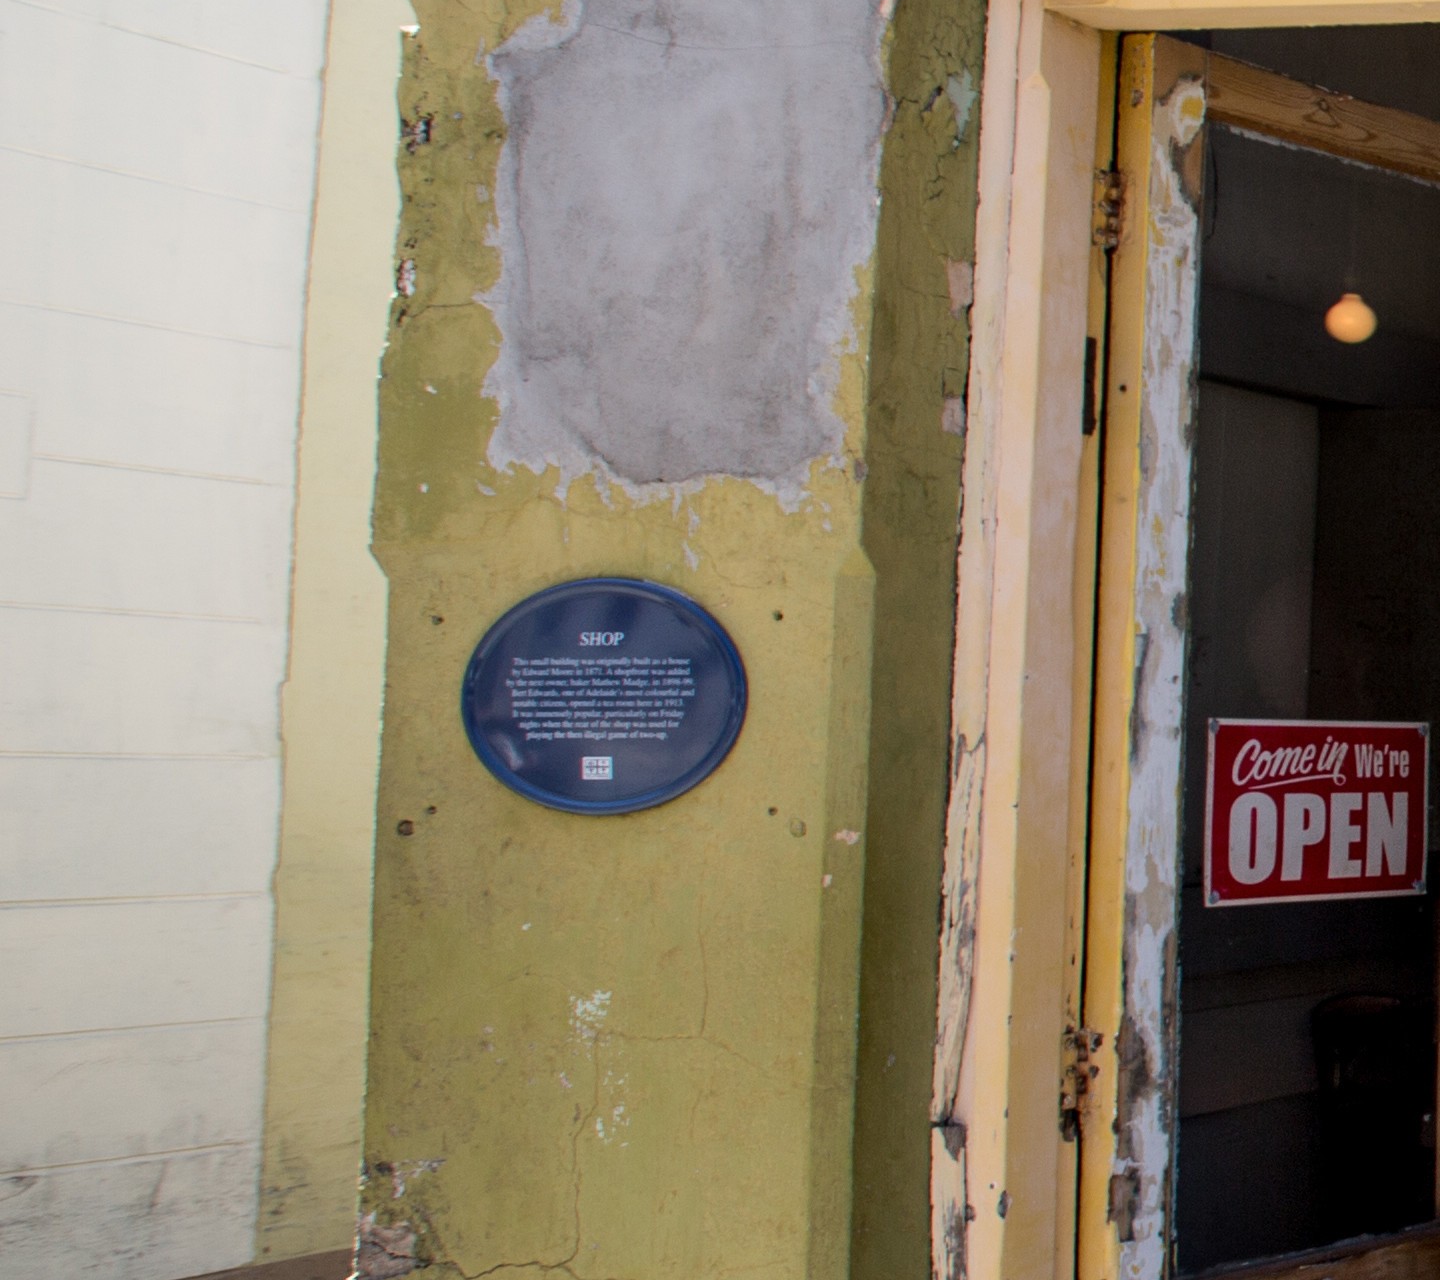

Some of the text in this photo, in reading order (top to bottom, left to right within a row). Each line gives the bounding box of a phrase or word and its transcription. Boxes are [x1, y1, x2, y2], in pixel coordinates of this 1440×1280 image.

[578, 631, 625, 646] SHOP
[550, 657, 579, 667] building
[581, 657, 595, 667] was
[651, 668, 666, 677] was
[1232, 735, 1410, 786] Come in We're
[1228, 791, 1409, 885] OPEN
